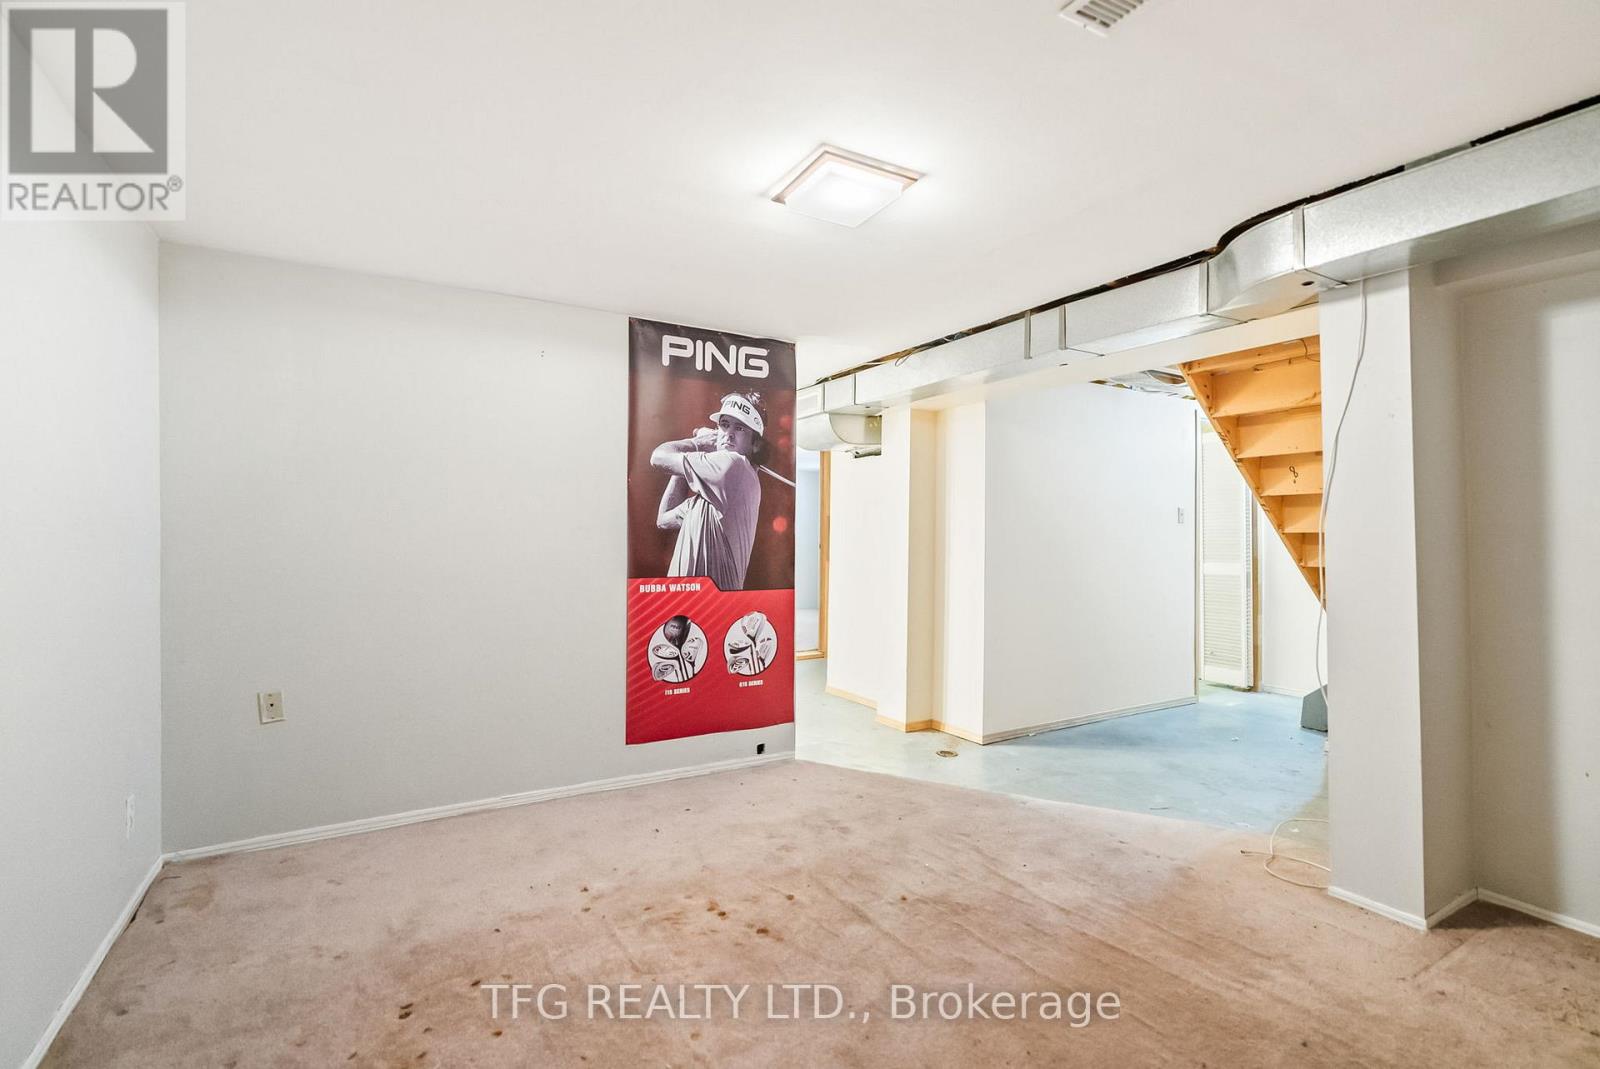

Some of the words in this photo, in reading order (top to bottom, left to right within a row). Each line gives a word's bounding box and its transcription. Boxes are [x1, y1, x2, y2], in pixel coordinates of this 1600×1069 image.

[661, 334, 770, 379] PING
[724, 400, 751, 415] PING
[639, 584, 667, 593] BUBBA
[669, 583, 701, 592] WATSON
